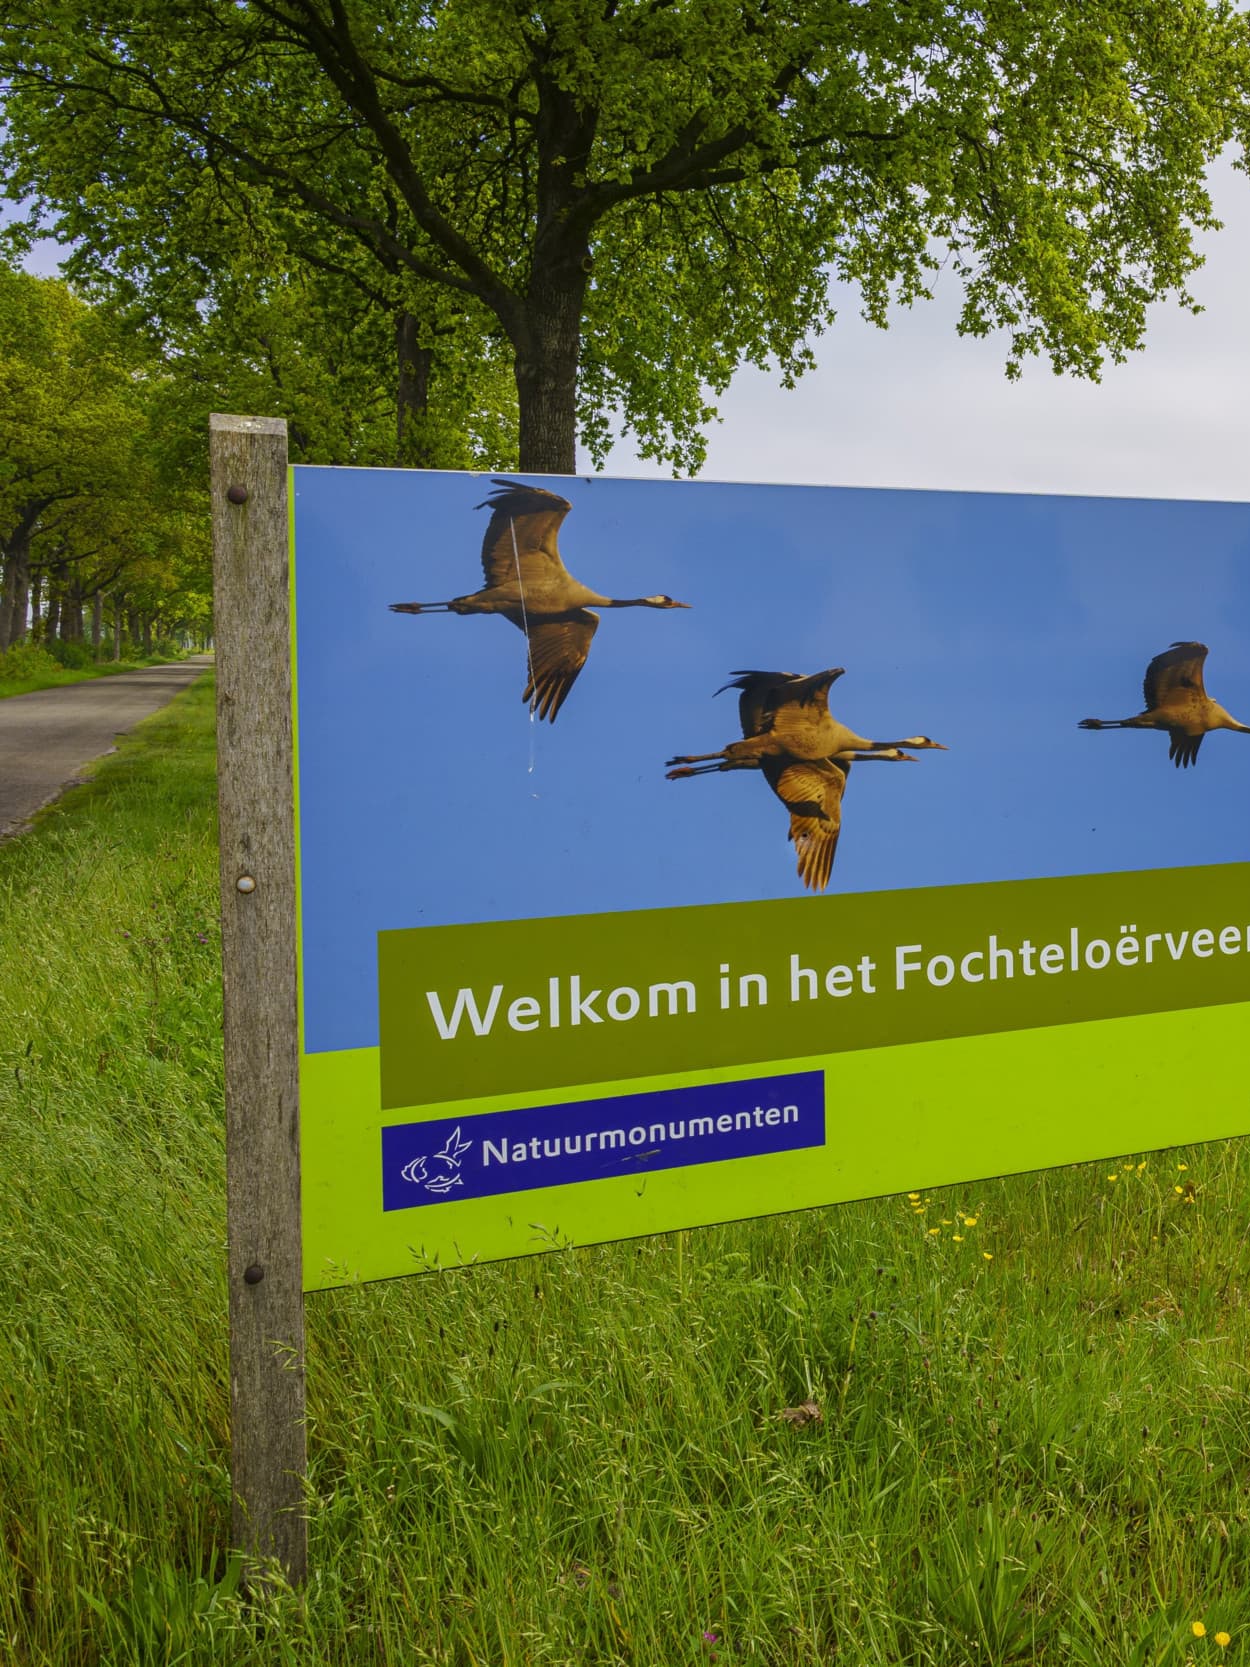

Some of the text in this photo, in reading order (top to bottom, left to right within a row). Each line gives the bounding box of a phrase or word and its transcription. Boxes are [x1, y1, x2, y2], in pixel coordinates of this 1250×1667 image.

[426, 974, 697, 1040] Welkom
[719, 963, 768, 1009] in
[790, 954, 876, 1002] het
[483, 1105, 799, 1167] Natuurmonumenten
